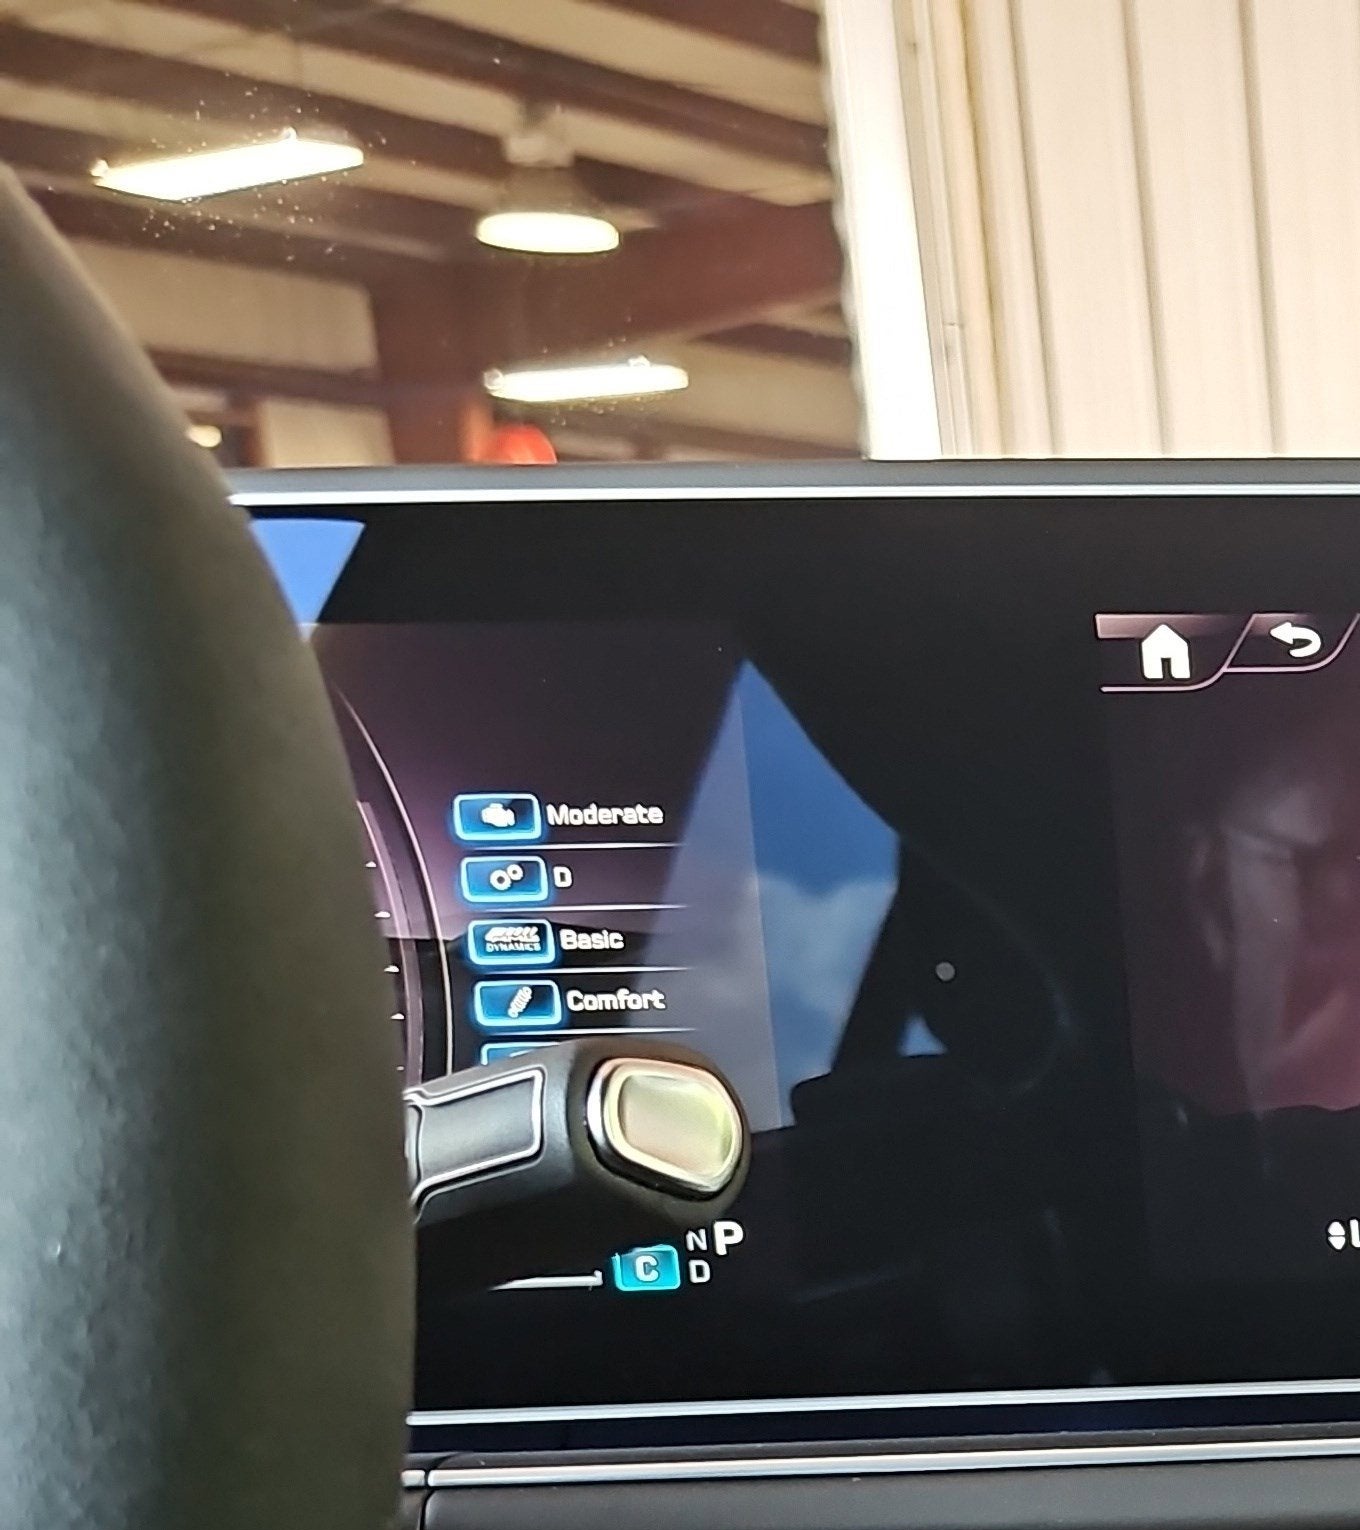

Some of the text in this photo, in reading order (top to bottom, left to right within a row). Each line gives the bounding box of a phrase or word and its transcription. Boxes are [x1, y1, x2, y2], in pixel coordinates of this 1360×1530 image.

[547, 803, 664, 826] Moderate
[554, 867, 573, 888] D
[559, 928, 625, 950] Basic
[566, 990, 667, 1013] Comfort
[686, 1230, 708, 1252] N
[714, 1220, 745, 1256] P
[636, 1256, 660, 1283] C
[690, 1261, 712, 1284] D
